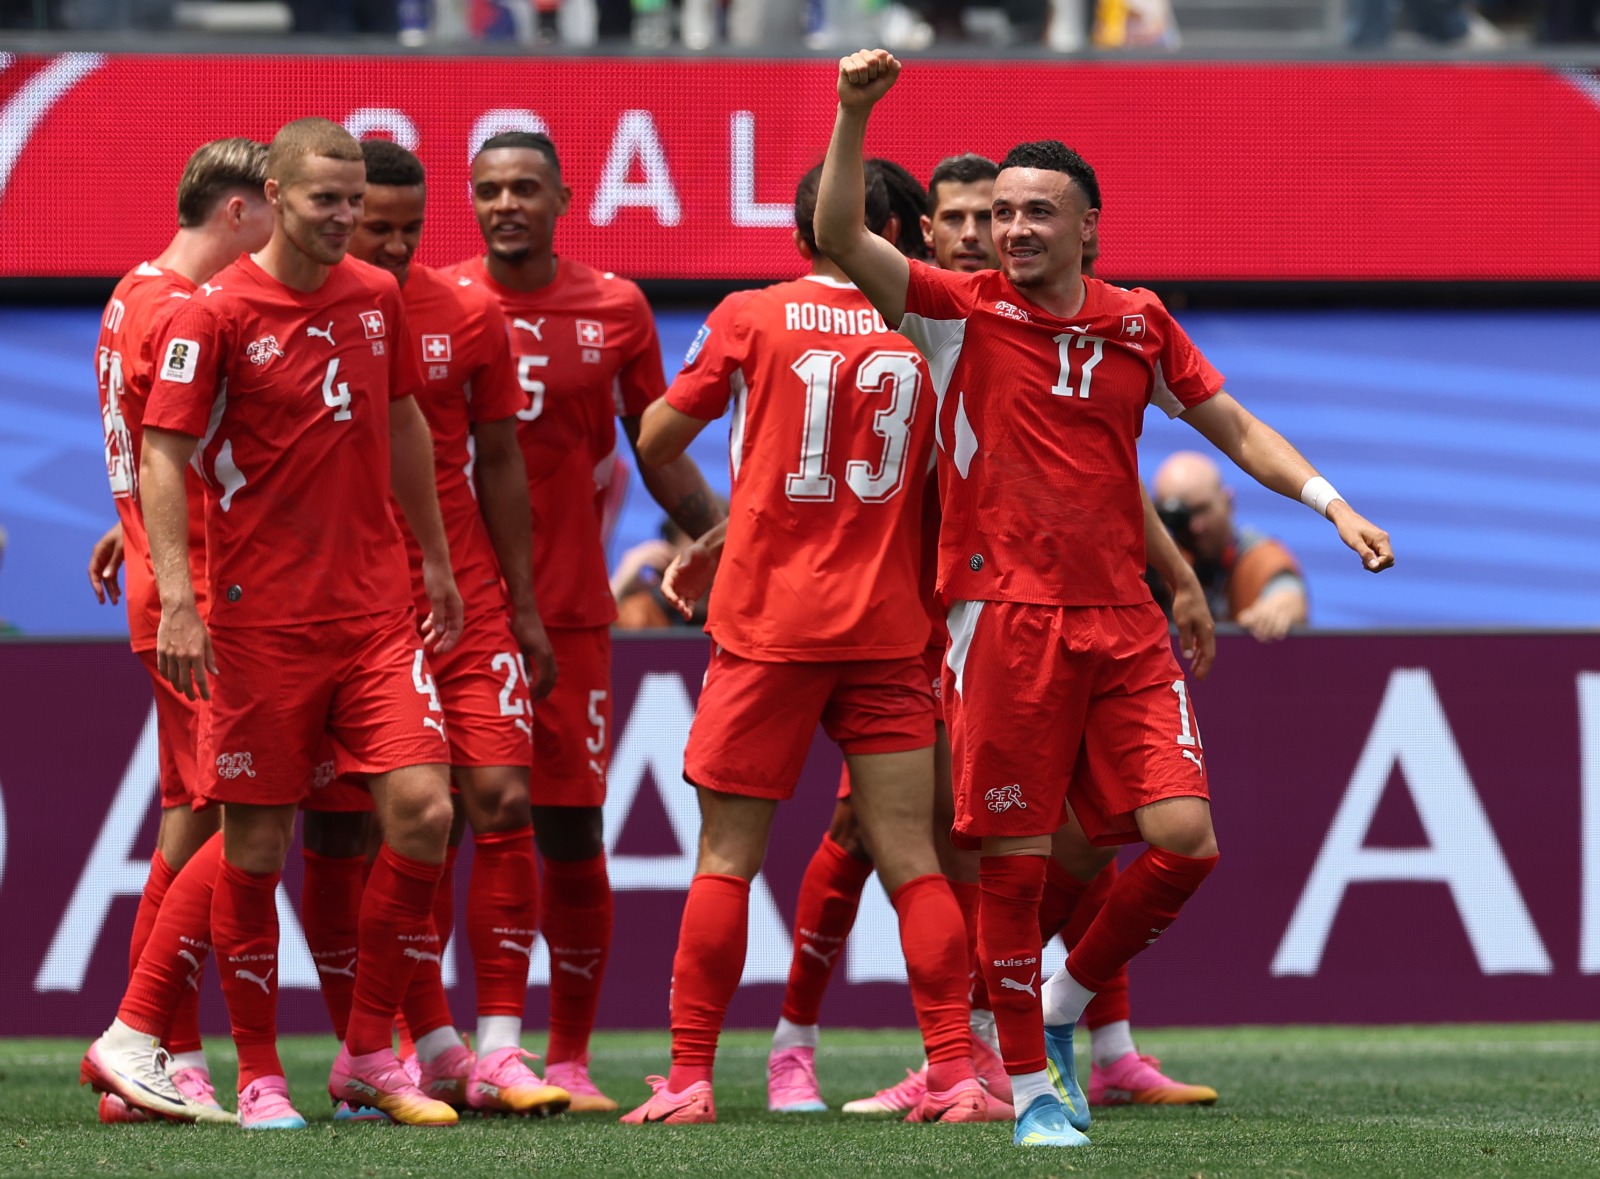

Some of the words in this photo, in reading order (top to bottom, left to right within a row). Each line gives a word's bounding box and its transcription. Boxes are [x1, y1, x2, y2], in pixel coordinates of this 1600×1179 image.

[321, 358, 352, 422] 4
[515, 355, 550, 421] 5
[1051, 333, 1107, 399] 17
[785, 349, 922, 503] 13
[412, 649, 442, 711] 4
[585, 689, 607, 754] 5
[1171, 680, 1203, 749] 1
[992, 957, 1037, 967] suisse
